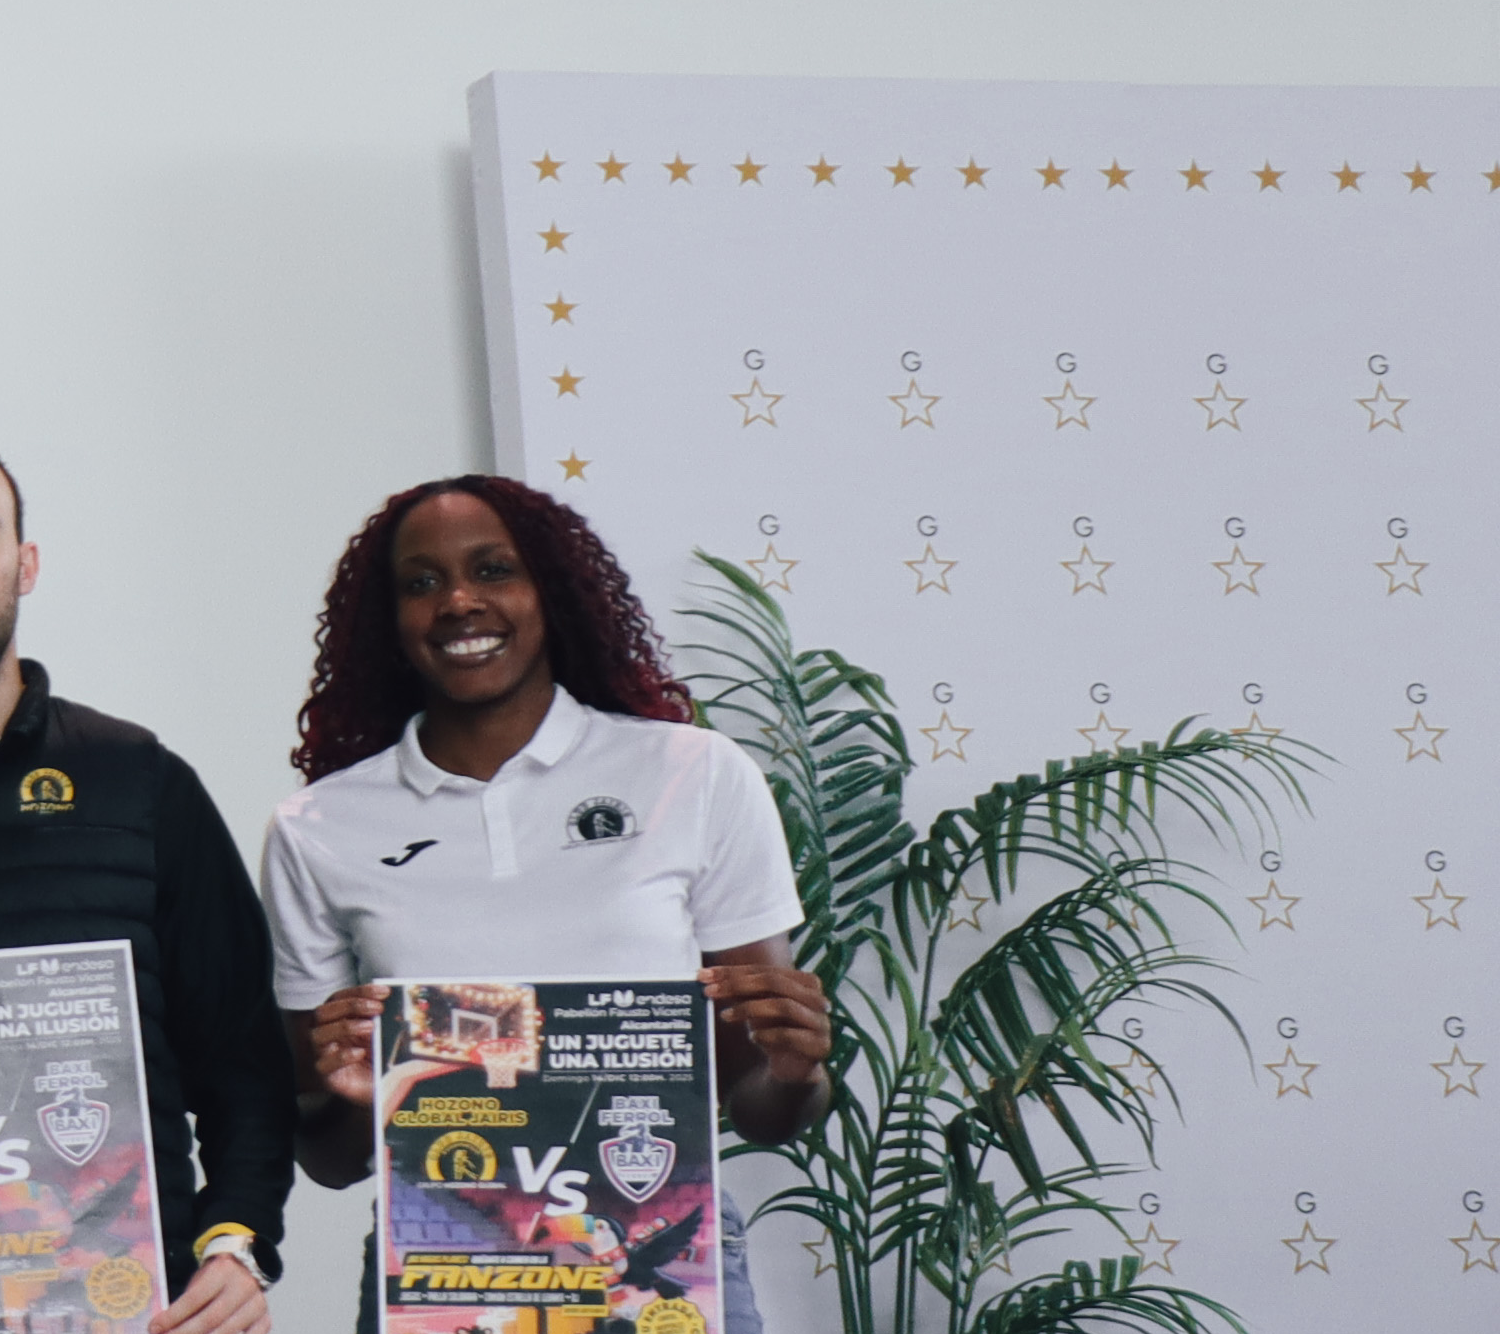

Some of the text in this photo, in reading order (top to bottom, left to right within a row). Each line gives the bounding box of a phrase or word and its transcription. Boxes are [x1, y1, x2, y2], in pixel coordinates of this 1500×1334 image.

[743, 348, 765, 372] G
[900, 350, 923, 373] G
[1055, 351, 1078, 375] G
[1205, 352, 1228, 376] G
[1367, 353, 1390, 377] G
[757, 513, 781, 537] G
[916, 514, 939, 538] G
[1072, 515, 1095, 539] G
[1224, 516, 1246, 540] G
[1386, 516, 1409, 540] G
[932, 681, 955, 705] G
[1089, 681, 1112, 706] G
[1241, 682, 1264, 706] G
[1405, 682, 1428, 706] G
[1259, 849, 1282, 874] G
[1424, 849, 1447, 873] G
[589, 992, 612, 1005] LF
[610, 1007, 651, 1017] Fausto
[653, 1006, 693, 1017] Vicent
[36, 1012, 119, 1036] ILUSIÓN
[620, 1019, 692, 1030] Alcantarilla
[1121, 1016, 1145, 1041] G
[1276, 1016, 1299, 1041] G
[1442, 1015, 1466, 1040] G
[549, 1034, 582, 1050] UN
[550, 1048, 692, 1068] UNA ILUSIÓN
[614, 1097, 658, 1110] BAXI
[600, 1110, 673, 1123] FERROL
[1138, 1191, 1162, 1217] G
[1294, 1190, 1317, 1215] G
[1461, 1189, 1485, 1214] G
